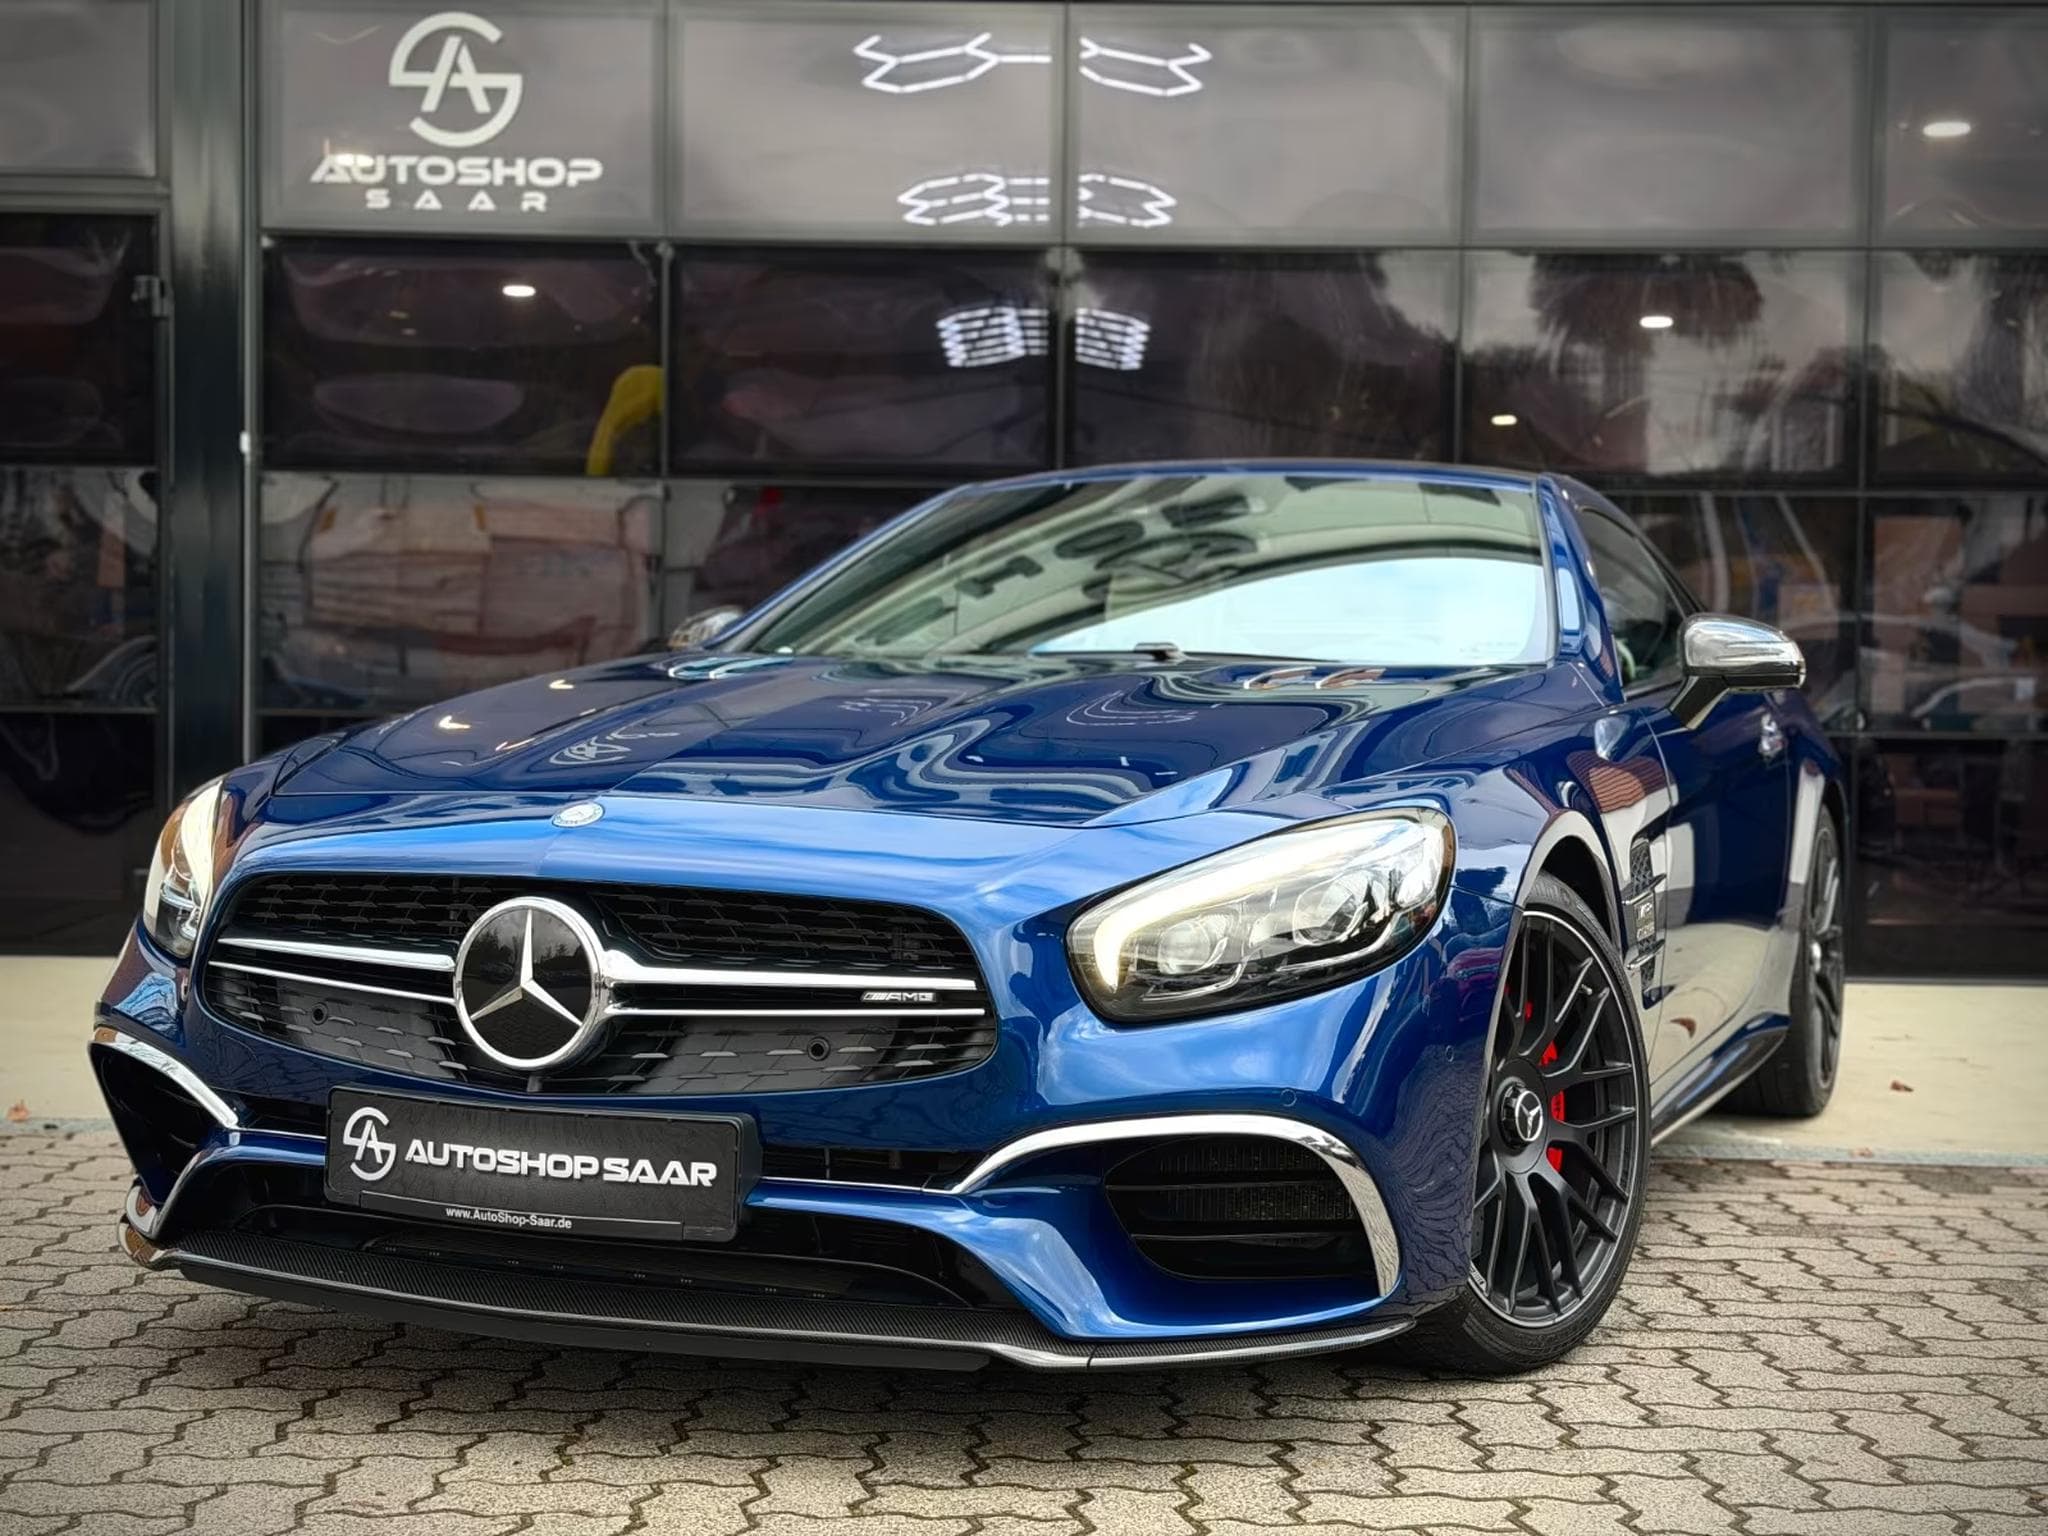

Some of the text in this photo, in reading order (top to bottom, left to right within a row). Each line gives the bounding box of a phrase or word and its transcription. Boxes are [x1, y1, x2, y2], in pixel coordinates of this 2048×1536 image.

[309, 153, 604, 188] AUTOSHOP
[364, 188, 548, 212] SAAR
[880, 991, 936, 1002] AMG
[404, 1138, 718, 1188] AUTOSHOP SAAR
[445, 1206, 573, 1230] www.AutoShop-Saar.de
